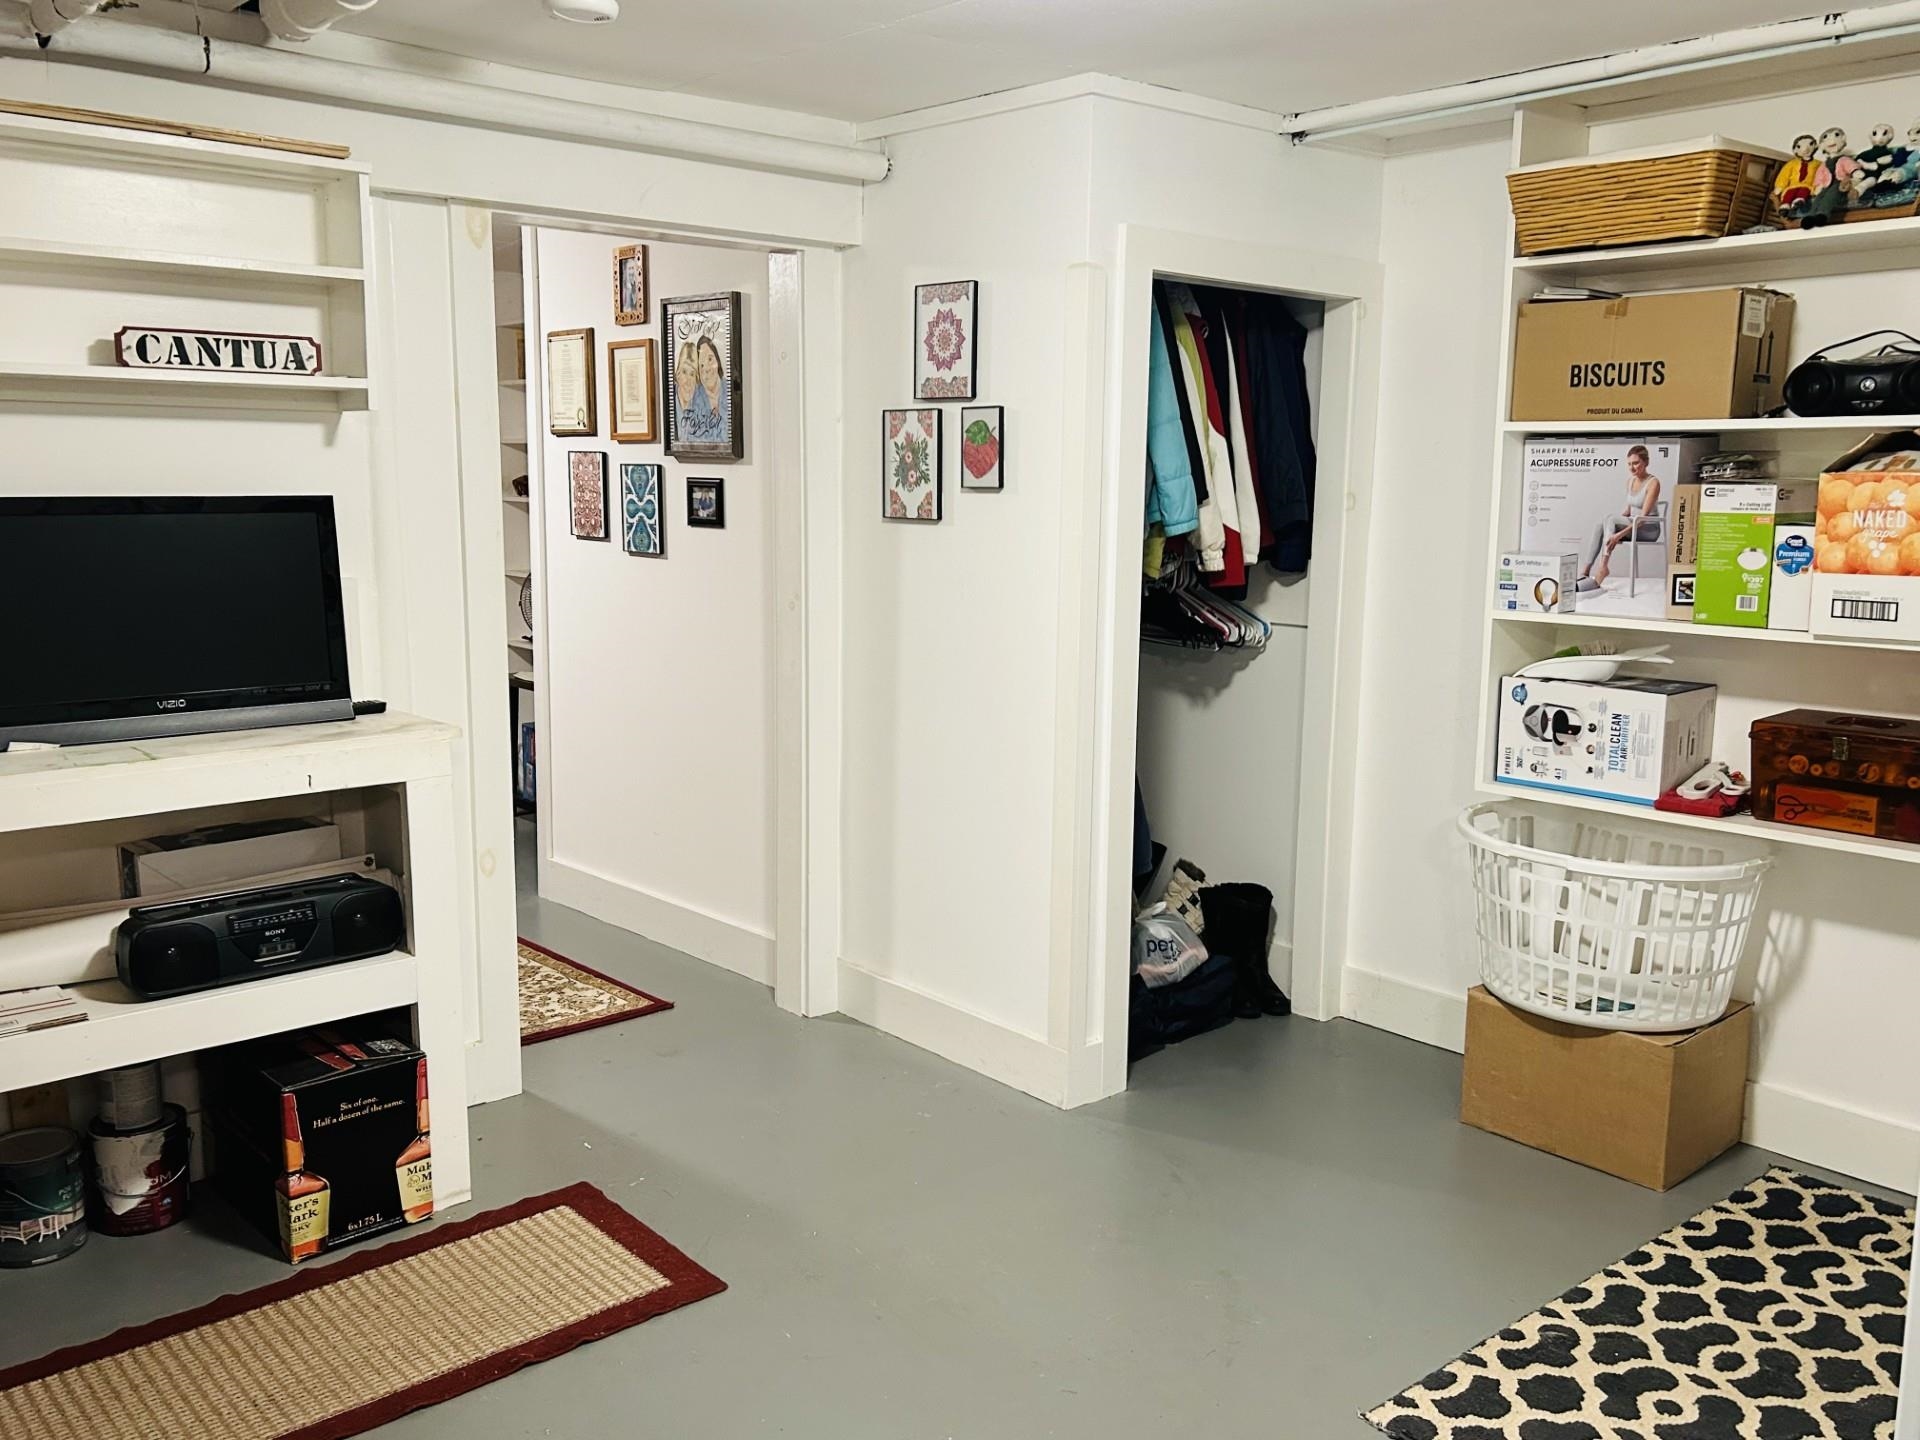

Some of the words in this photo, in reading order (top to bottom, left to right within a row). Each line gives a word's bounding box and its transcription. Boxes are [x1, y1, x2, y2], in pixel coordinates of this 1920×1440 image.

[135, 333, 308, 371] CANTUA
[1570, 361, 1665, 388] BISCUITS
[1530, 459, 1591, 467] ACUPRESSURE
[1592, 458, 1619, 467] FOOT
[1852, 509, 1907, 529] NAKED
[1861, 530, 1899, 543] grape
[157, 699, 187, 710] VIZIO
[264, 927, 287, 936] SONY
[340, 1102, 352, 1111] Six
[353, 1098, 362, 1108] of
[313, 1116, 331, 1128] Half
[338, 1111, 361, 1122] dozen
[361, 1105, 370, 1115] of
[370, 1104, 382, 1112] the
